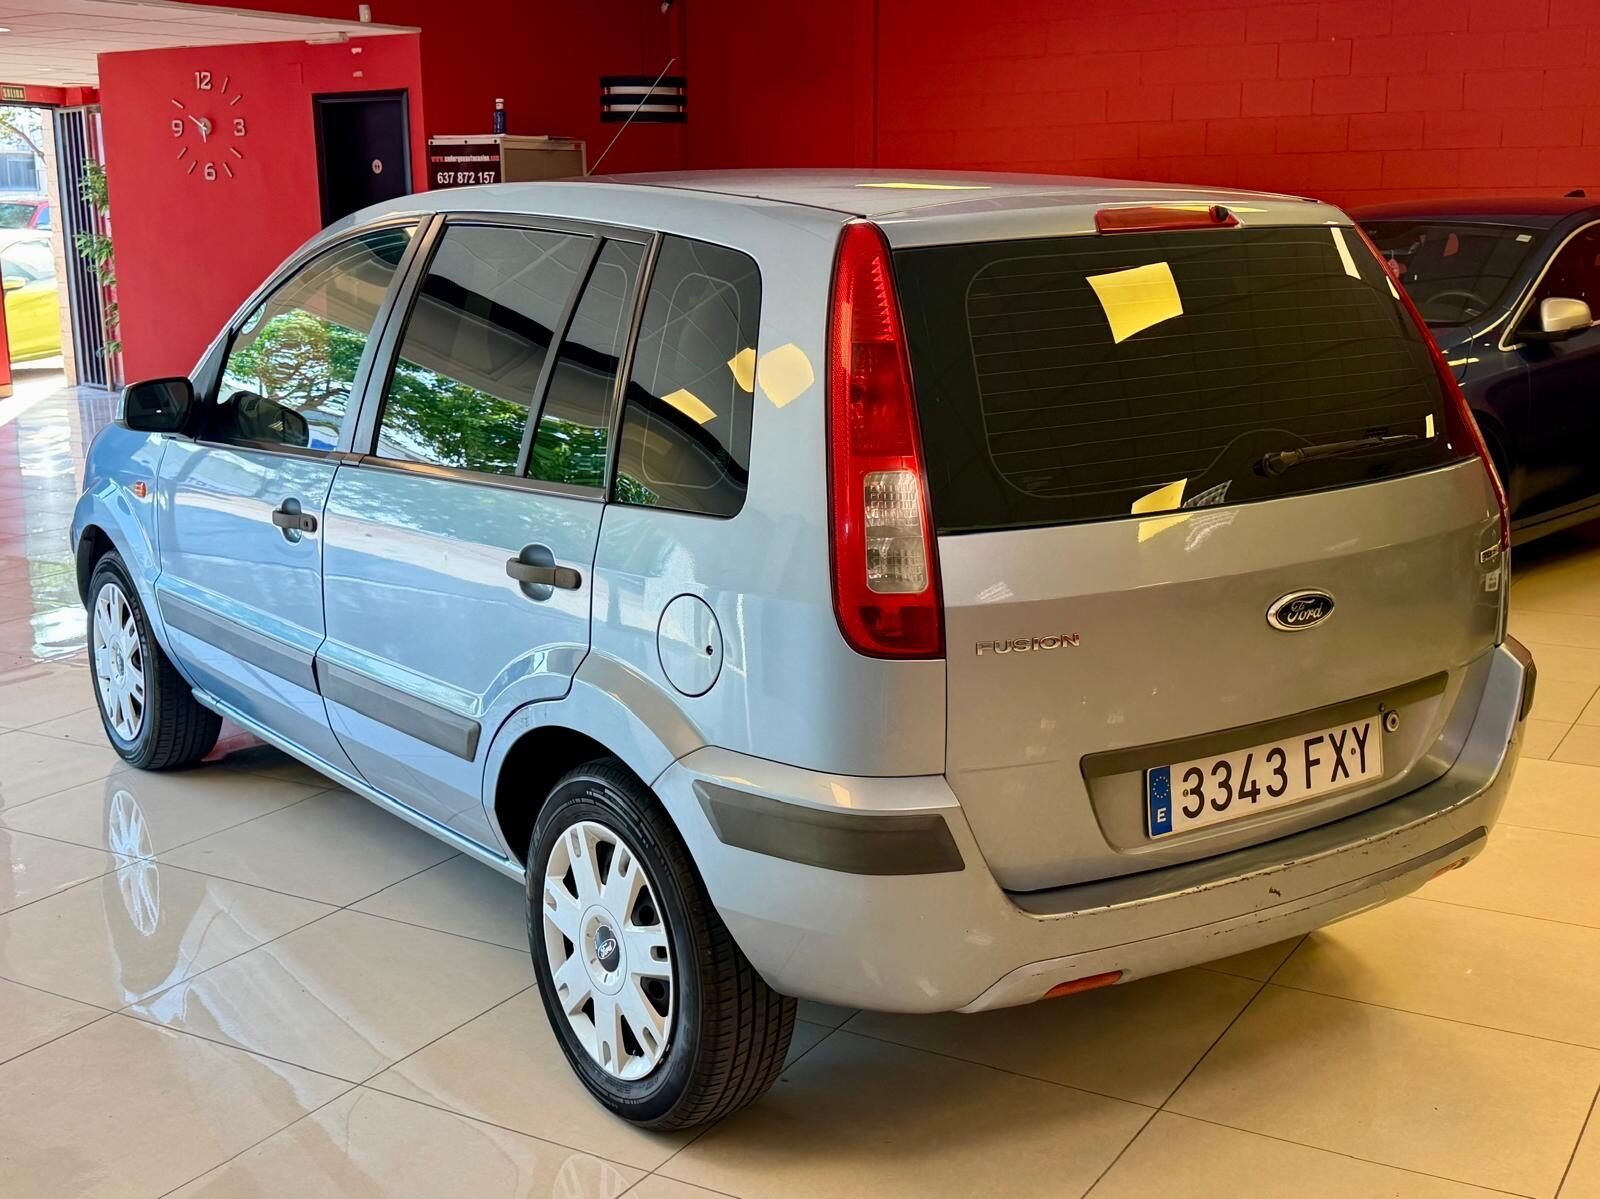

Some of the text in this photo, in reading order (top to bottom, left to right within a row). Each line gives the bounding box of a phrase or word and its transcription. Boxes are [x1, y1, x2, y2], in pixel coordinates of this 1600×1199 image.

[194, 71, 211, 90] 12
[171, 119, 183, 137] 9
[233, 118, 246, 137] 3
[204, 162, 216, 181] 6
[437, 171, 496, 184] 637 872 157
[1287, 598, 1324, 623] Ford
[975, 632, 1080, 656] FUSION
[1181, 722, 1370, 819] 3343 FXY
[1157, 807, 1167, 823] E
